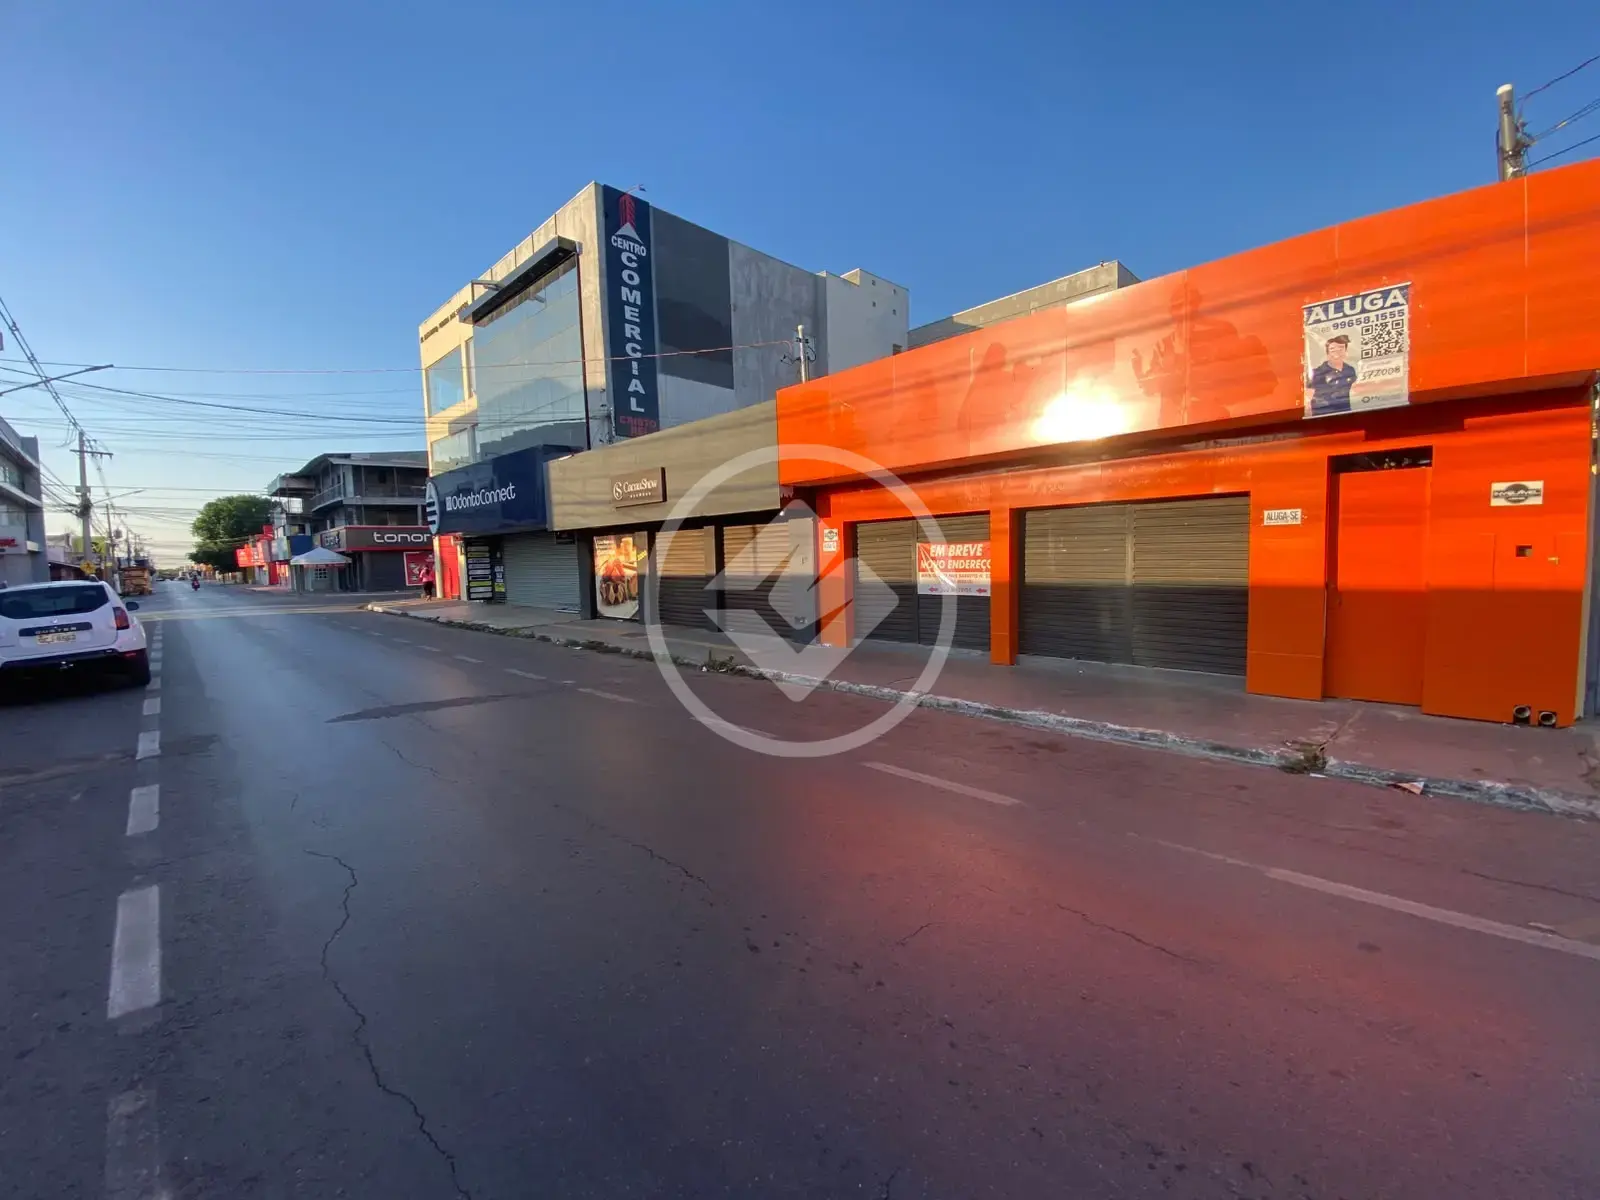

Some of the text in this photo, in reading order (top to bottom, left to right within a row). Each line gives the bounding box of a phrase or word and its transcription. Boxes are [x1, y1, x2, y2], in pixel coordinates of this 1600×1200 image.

[611, 235, 647, 257] CENTRO
[1307, 288, 1407, 325] ALUGA
[1332, 309, 1405, 331] 99658.1555
[621, 251, 646, 413] COMERCIAL
[451, 482, 516, 510] OdontoConnect
[1266, 510, 1300, 521] ALUGA-SE
[930, 543, 983, 557] EM BREVE
